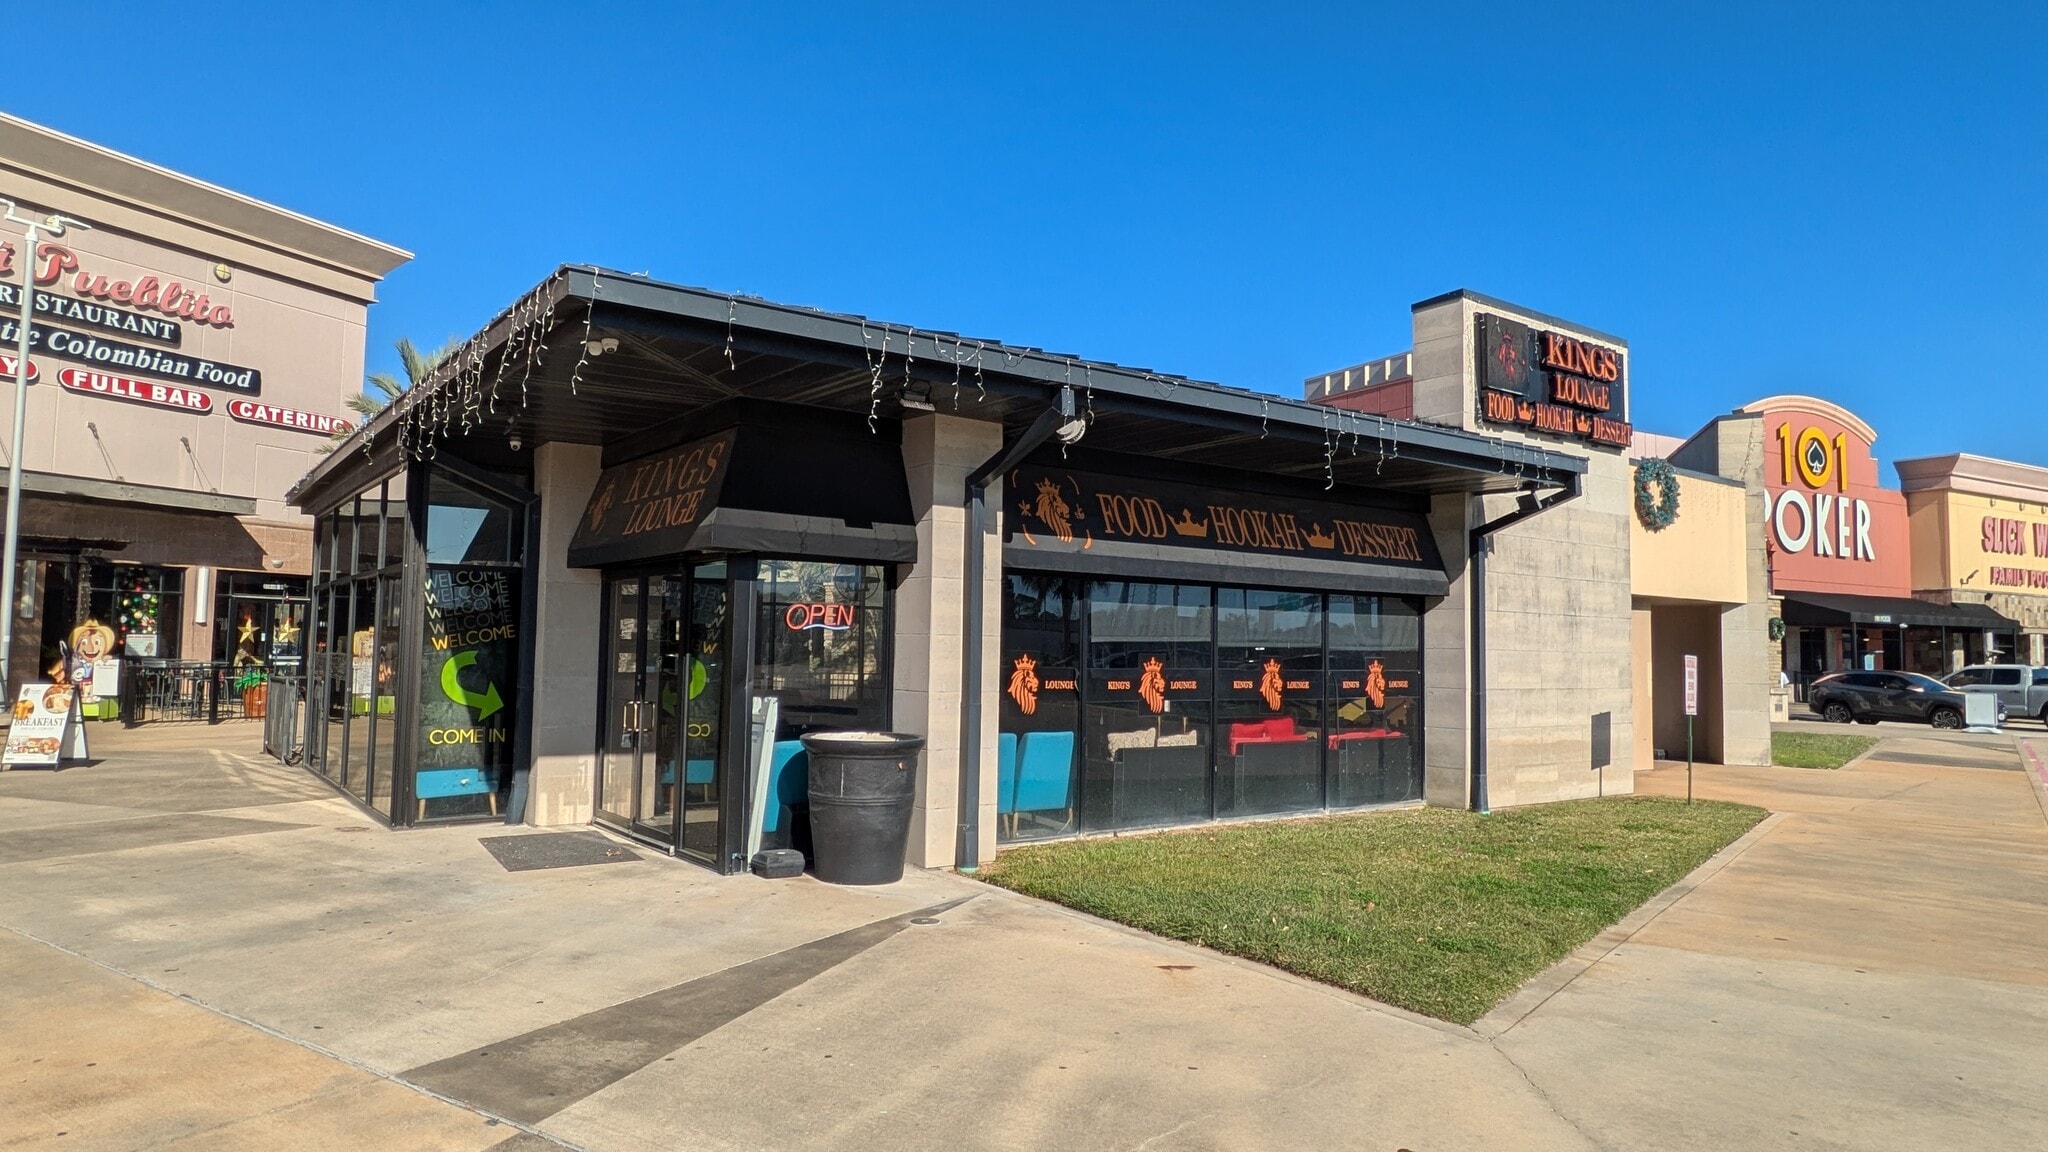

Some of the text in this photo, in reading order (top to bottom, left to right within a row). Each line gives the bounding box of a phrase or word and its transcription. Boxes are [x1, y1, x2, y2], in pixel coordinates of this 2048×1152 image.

[34, 243, 235, 329] Pueblito
[48, 331, 191, 377] Colombian
[198, 362, 253, 389] Food
[1546, 334, 1618, 382] KINGS
[73, 371, 143, 398] FULL
[152, 386, 203, 408] BAR
[1555, 374, 1610, 410] LOUNGE
[1487, 393, 1632, 447] FOOD HOOKAH DESSERT
[623, 441, 726, 504] KINGS
[1780, 422, 1847, 491] 101
[622, 488, 706, 536] LOUNGE
[1096, 493, 1423, 562] FOOD HOOKAH DESSERT
[1983, 516, 2027, 555] SLICK
[424, 580, 509, 605] WELCOME
[1991, 566, 2028, 587] FAMILY
[426, 594, 511, 620] WELCOME
[428, 609, 513, 635] WELCOME
[785, 604, 856, 630] OPEN
[431, 624, 516, 650] WELCOME
[1170, 681, 1197, 690] LOUNGE
[1287, 681, 1310, 689] LOUNGE
[14, 717, 65, 727] BREAKFAST
[429, 727, 506, 745] COME IN
